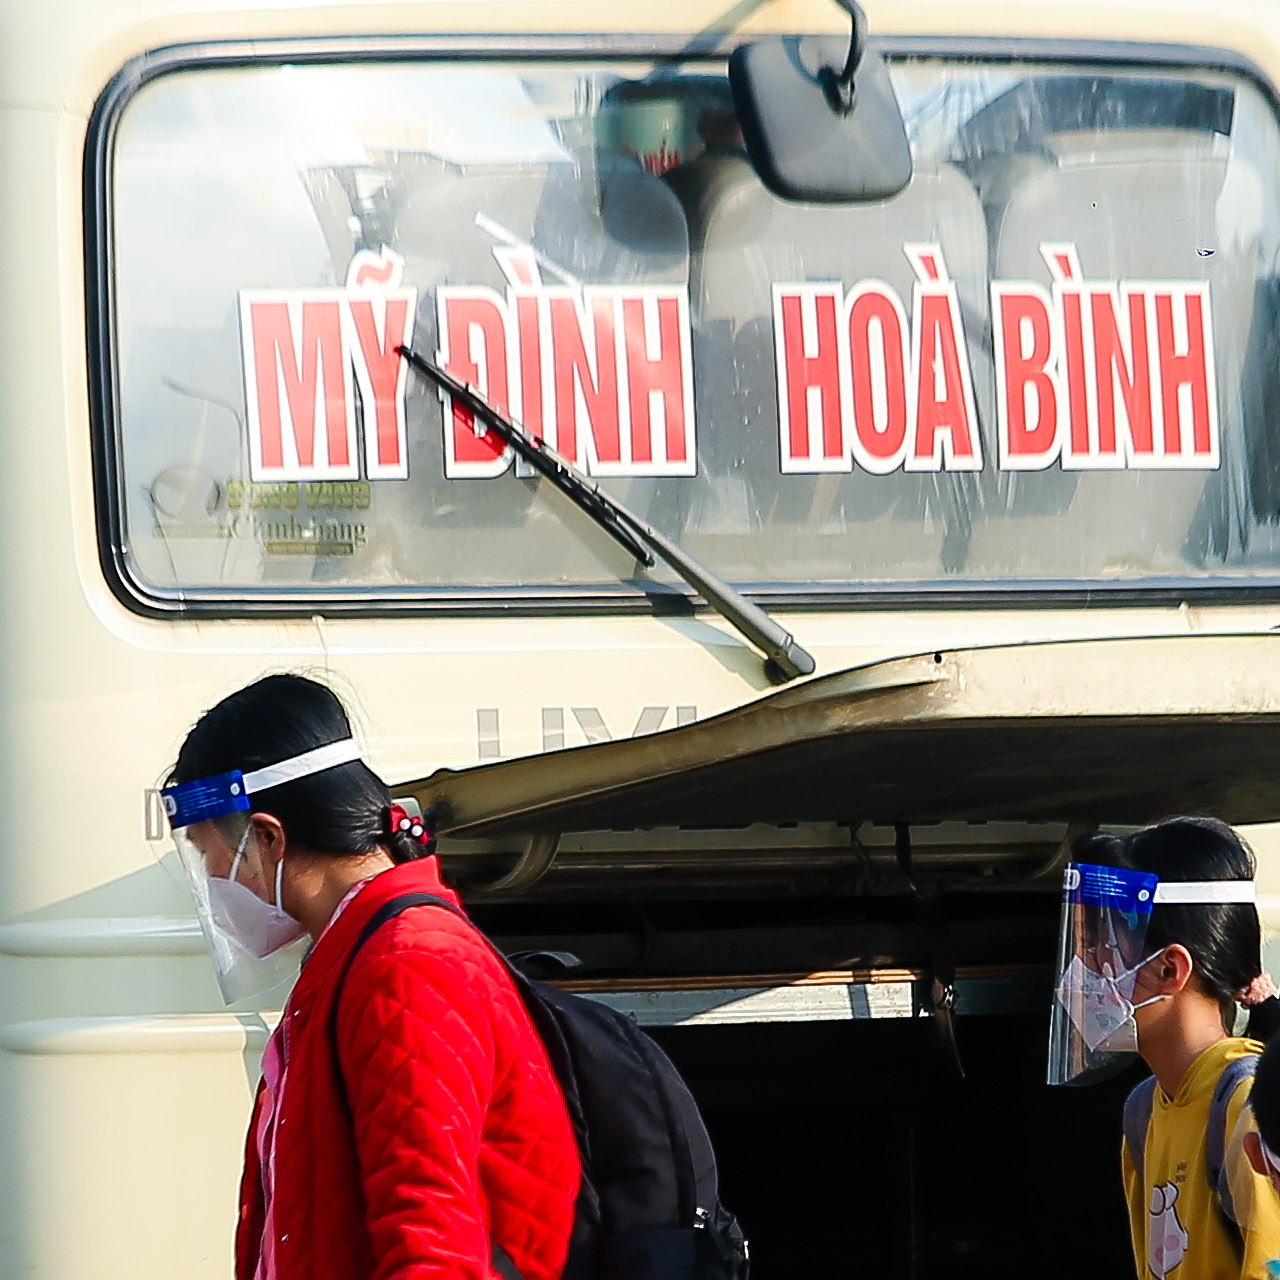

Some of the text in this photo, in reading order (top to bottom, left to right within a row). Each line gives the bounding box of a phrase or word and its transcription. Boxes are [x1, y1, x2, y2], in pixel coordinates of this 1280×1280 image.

[239, 244, 698, 482] MỸ ĐÌNH
[772, 241, 1220, 475] HOÀ BÌNH
